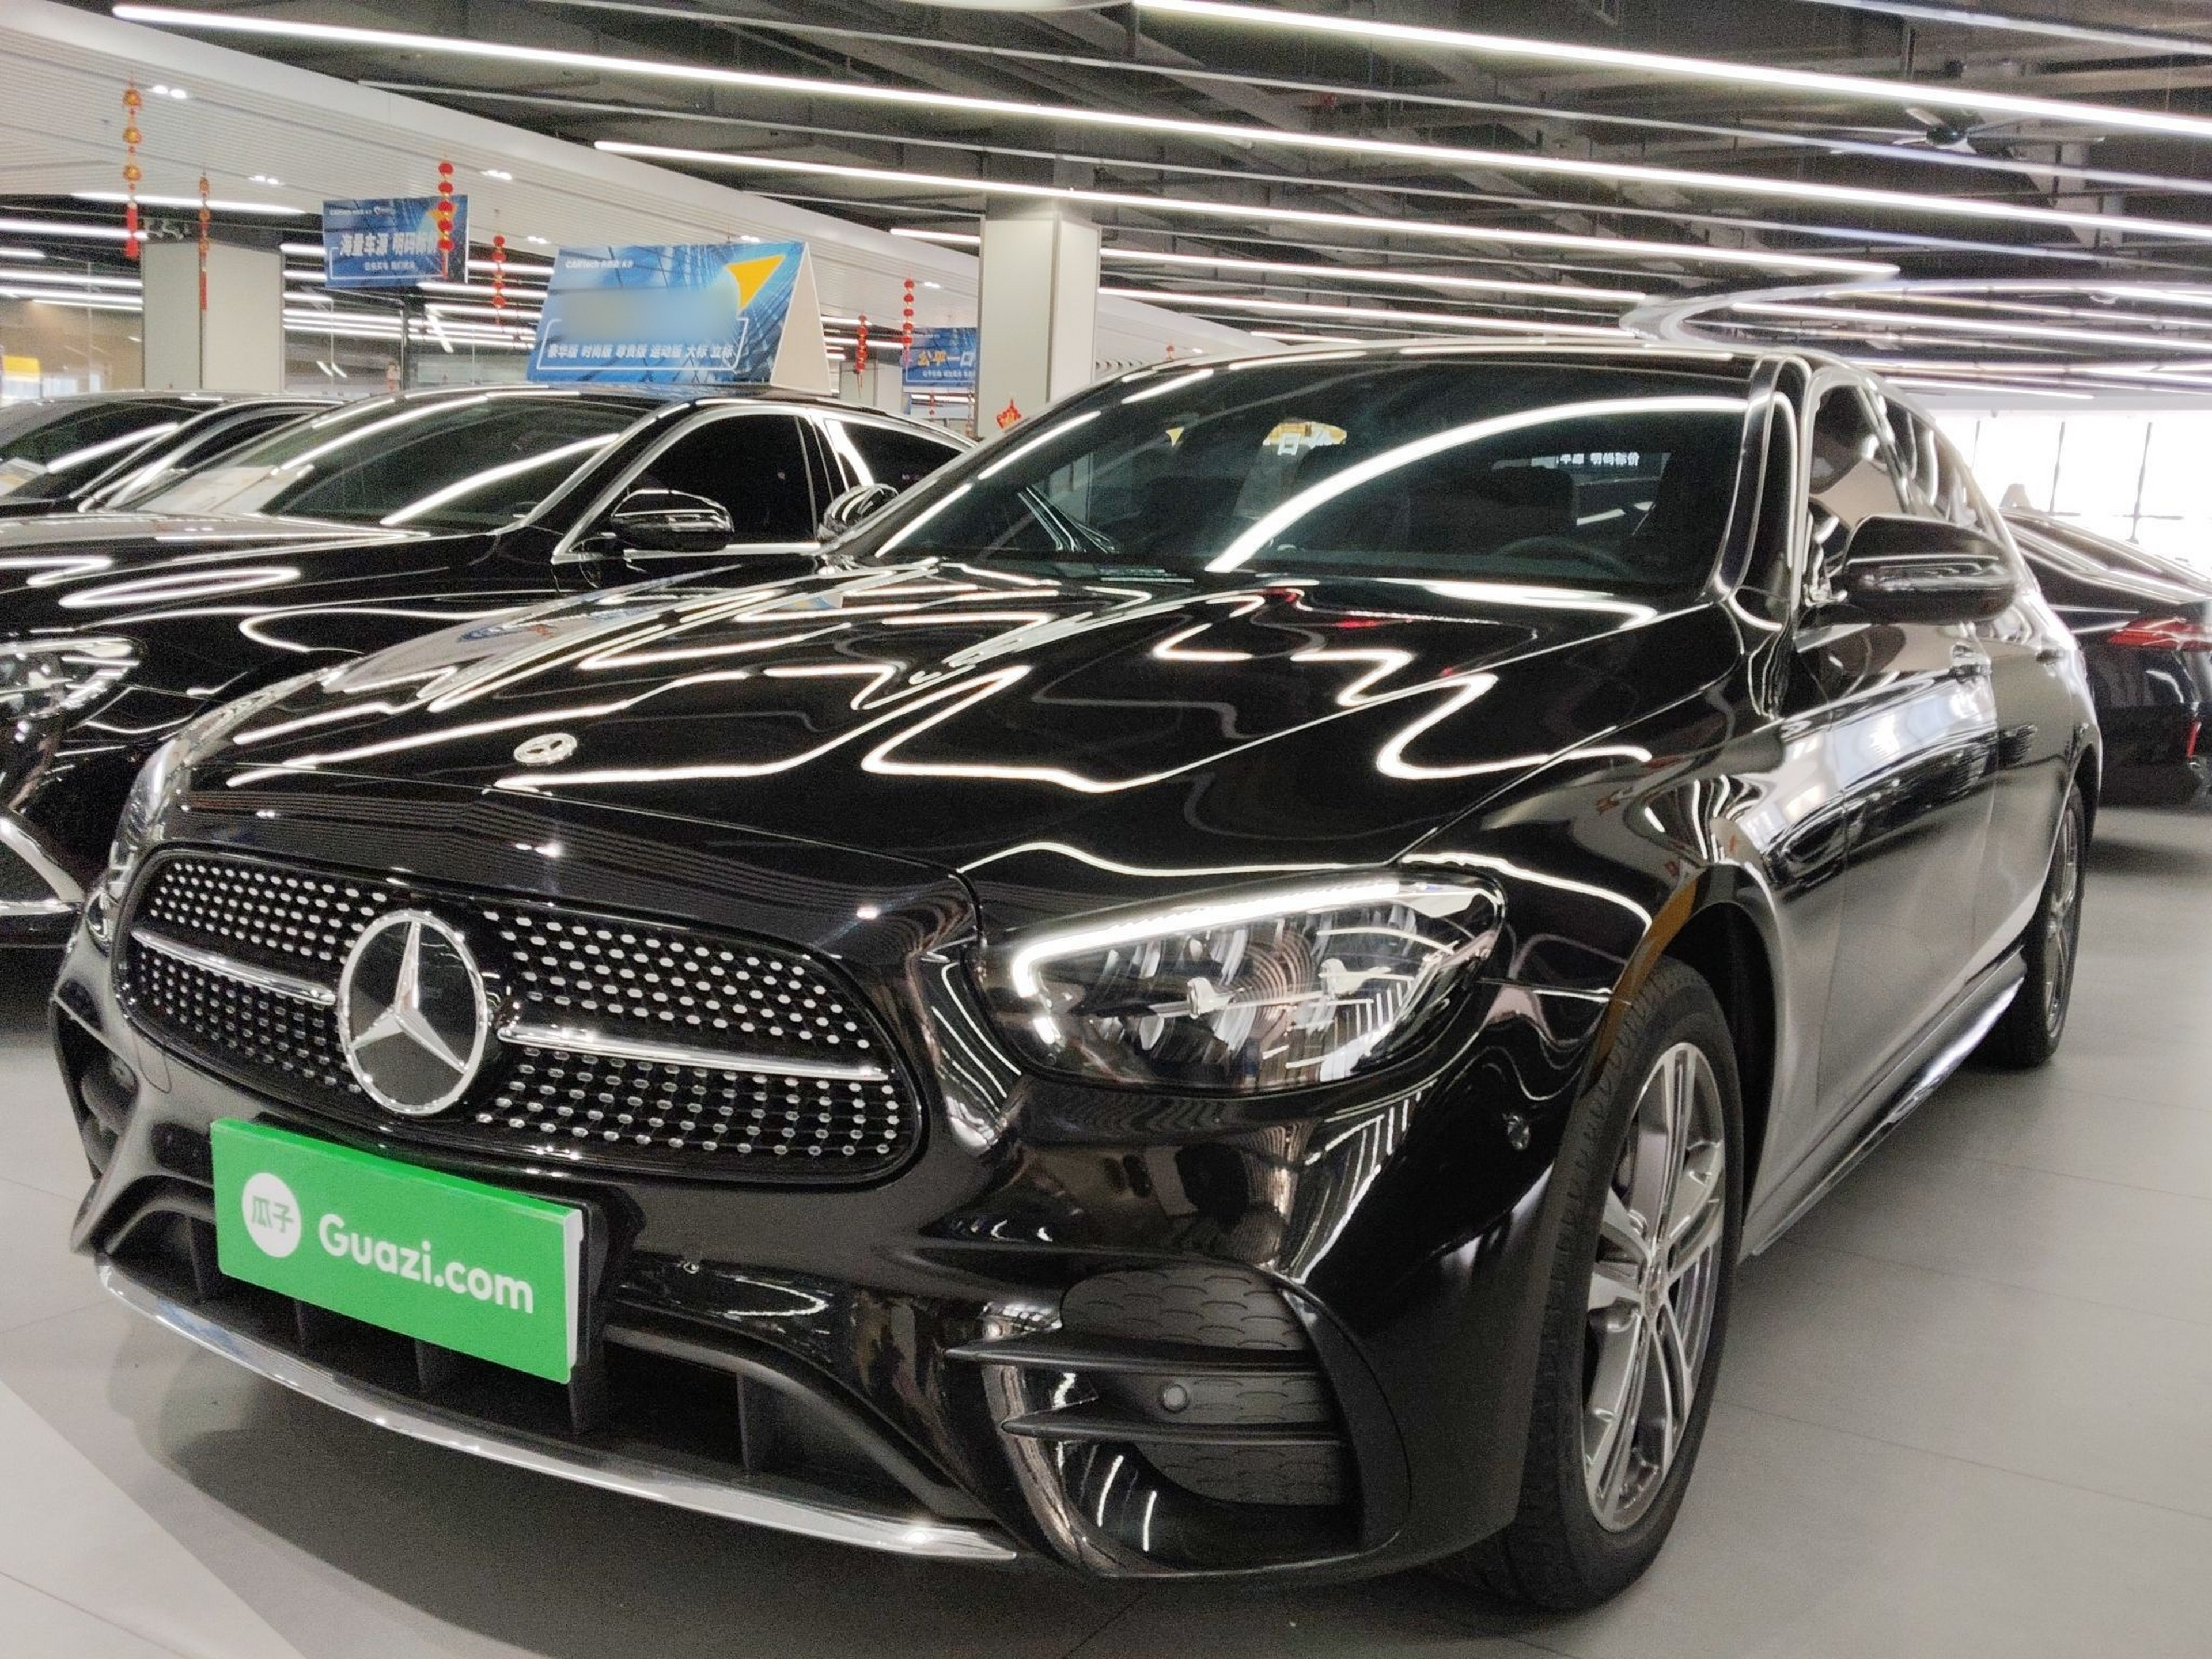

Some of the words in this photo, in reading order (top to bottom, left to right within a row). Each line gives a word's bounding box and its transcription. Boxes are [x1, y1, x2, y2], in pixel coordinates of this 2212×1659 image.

[650, 344, 683, 358] 运动版
[917, 350, 976, 367] 公平一口
[251, 1196, 293, 1233] 瓜子
[317, 1213, 533, 1315] Guazi.com
